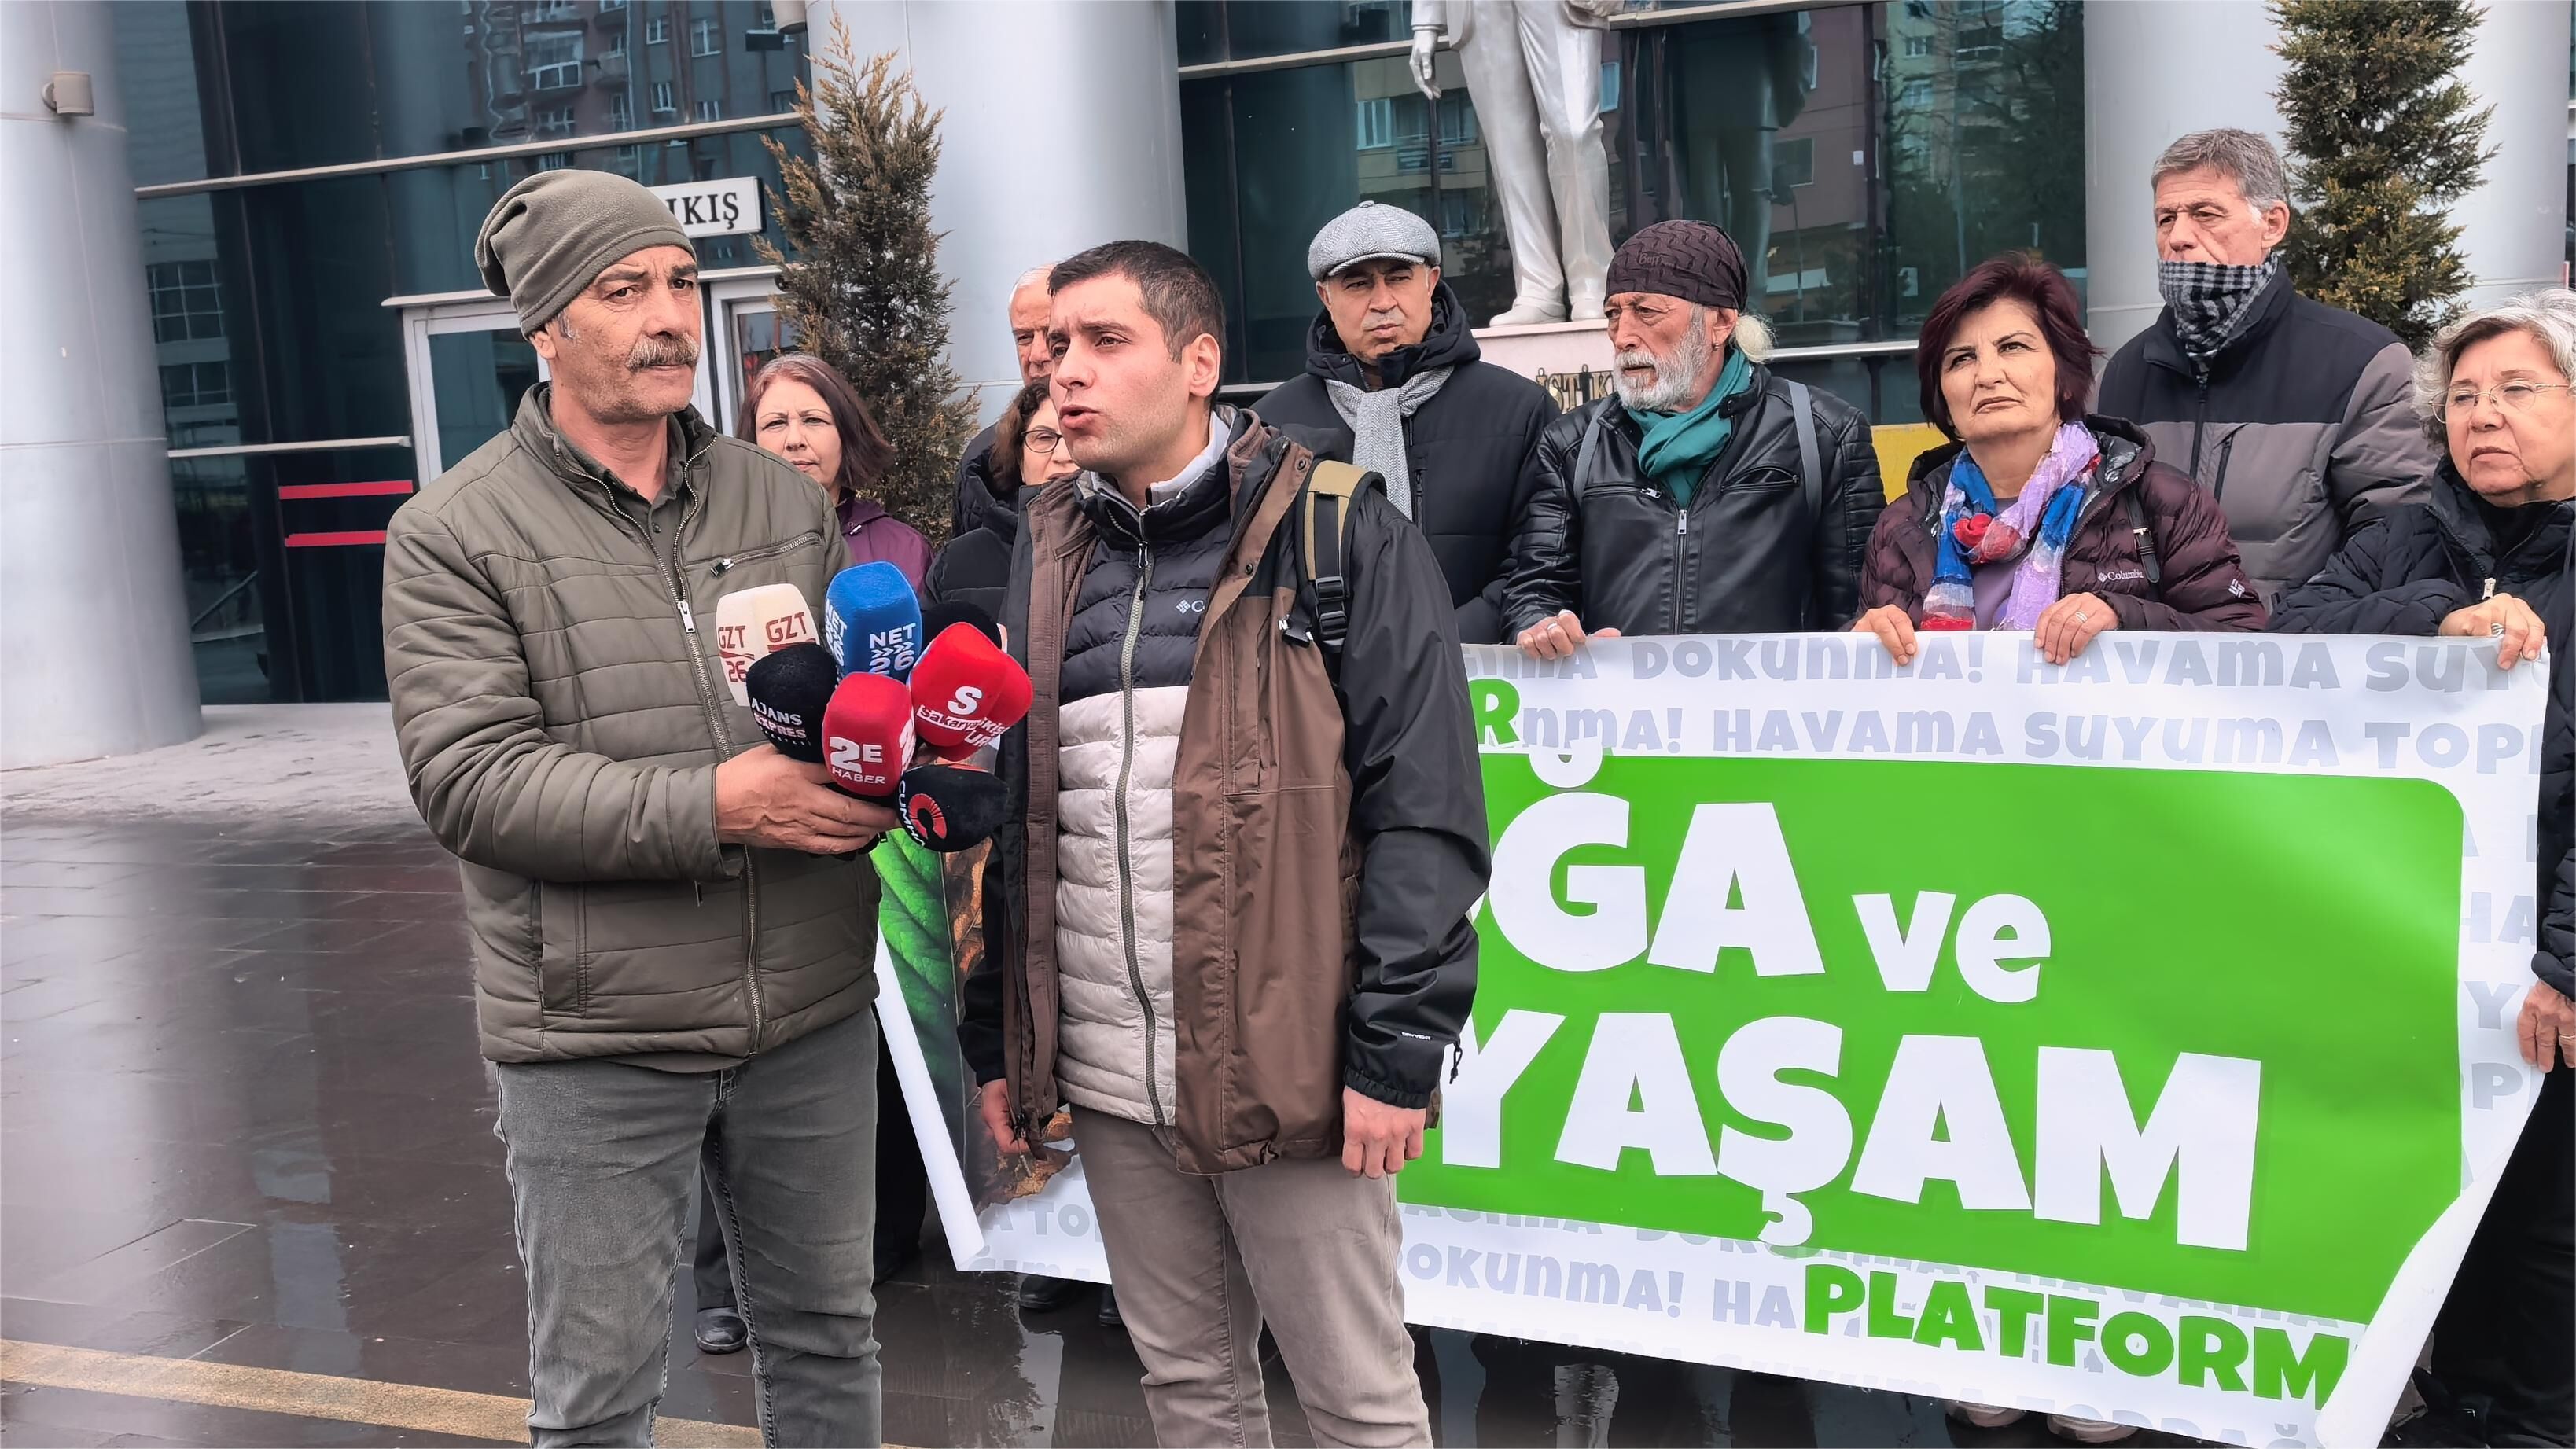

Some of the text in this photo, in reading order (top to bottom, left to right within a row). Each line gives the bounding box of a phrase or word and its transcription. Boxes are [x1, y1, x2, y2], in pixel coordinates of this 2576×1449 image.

[718, 625, 746, 649] GZT
[765, 611, 807, 643] GZT
[869, 622, 917, 649] NET
[726, 660, 747, 682] 26
[868, 650, 915, 675] 26
[2365, 642, 2548, 693] SUY
[752, 697, 803, 726] AJANS
[947, 686, 983, 715] S
[832, 767, 885, 785] HABER
[1469, 739, 2052, 1004] ĞA ve
[1441, 1008, 2262, 1252] YAŞAM
[1804, 1264, 2350, 1411] PLATFORM
